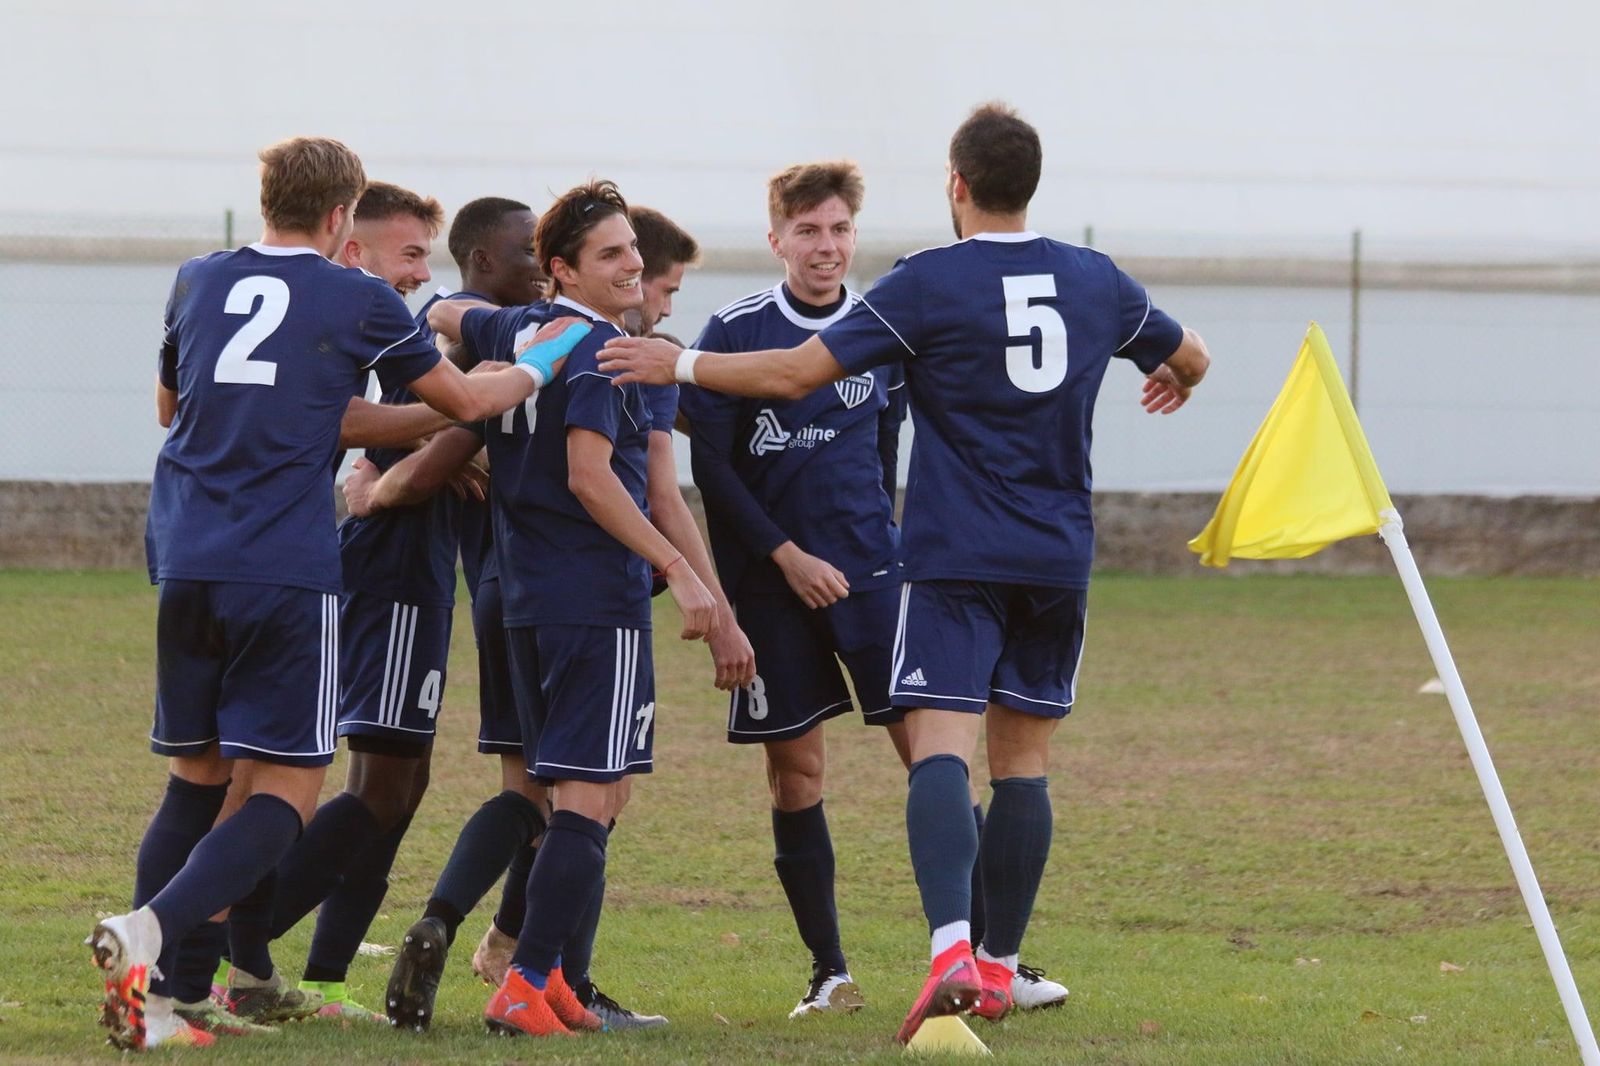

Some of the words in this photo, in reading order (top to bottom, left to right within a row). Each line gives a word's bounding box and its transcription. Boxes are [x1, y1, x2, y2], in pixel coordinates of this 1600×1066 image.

[213, 275, 291, 387] 2
[1002, 273, 1068, 393] 5
[788, 438, 816, 450] group
[417, 669, 443, 719] 4
[747, 674, 769, 721] 8
[901, 678, 928, 687] adidas
